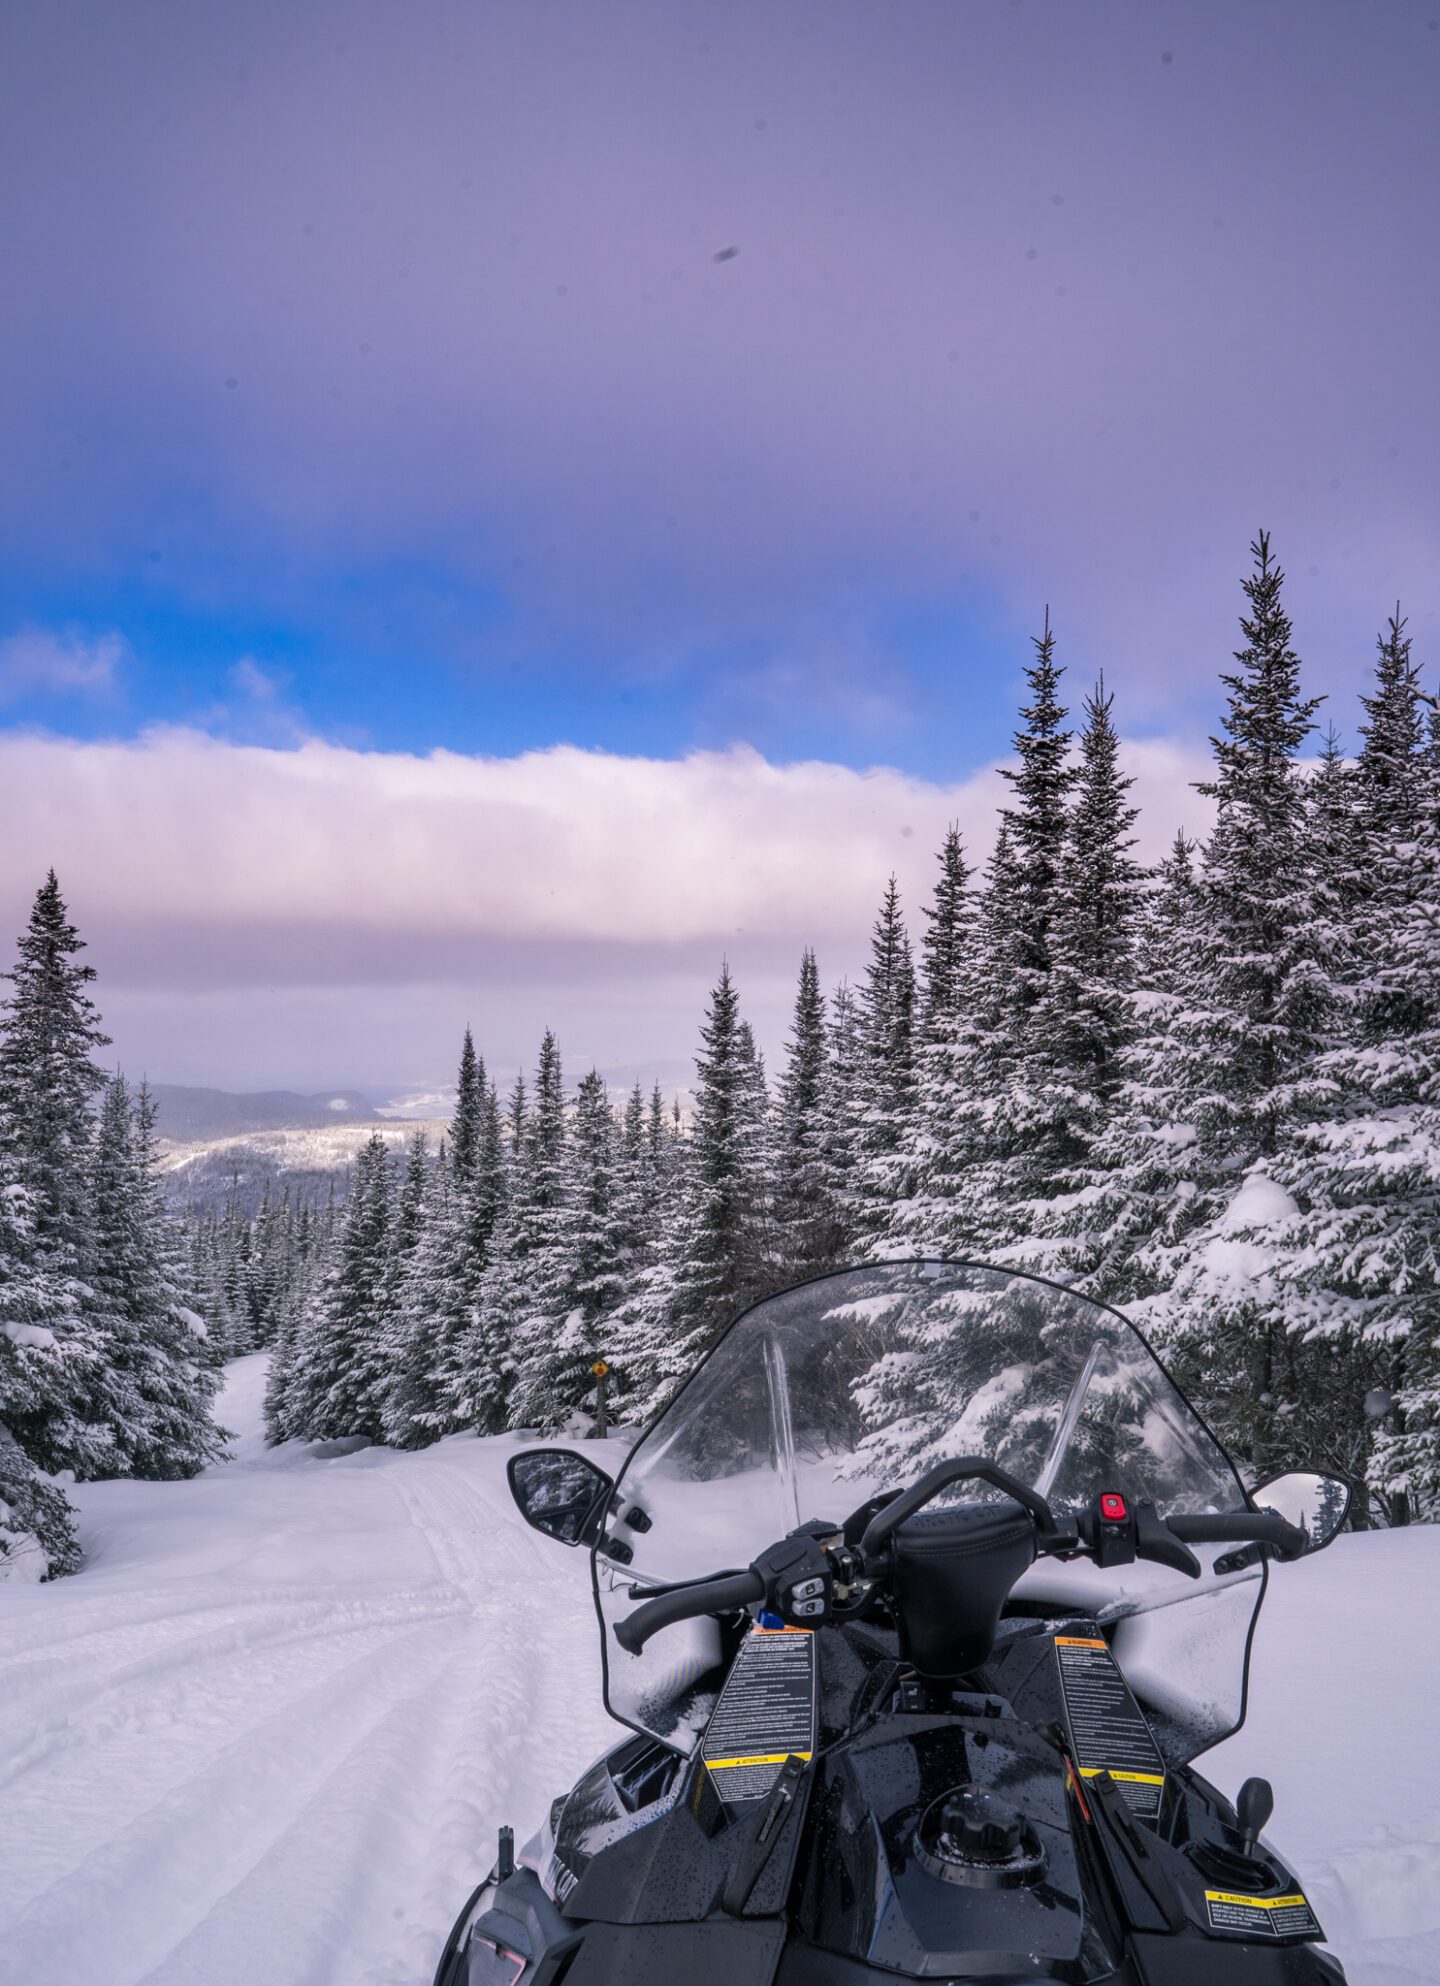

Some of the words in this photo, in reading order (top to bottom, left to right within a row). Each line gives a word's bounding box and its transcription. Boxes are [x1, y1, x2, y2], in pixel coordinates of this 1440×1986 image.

[911, 1509, 969, 1529] ARCTIC
[973, 1504, 1001, 1522] CAT
[1225, 1895, 1252, 1904] CAUTION
